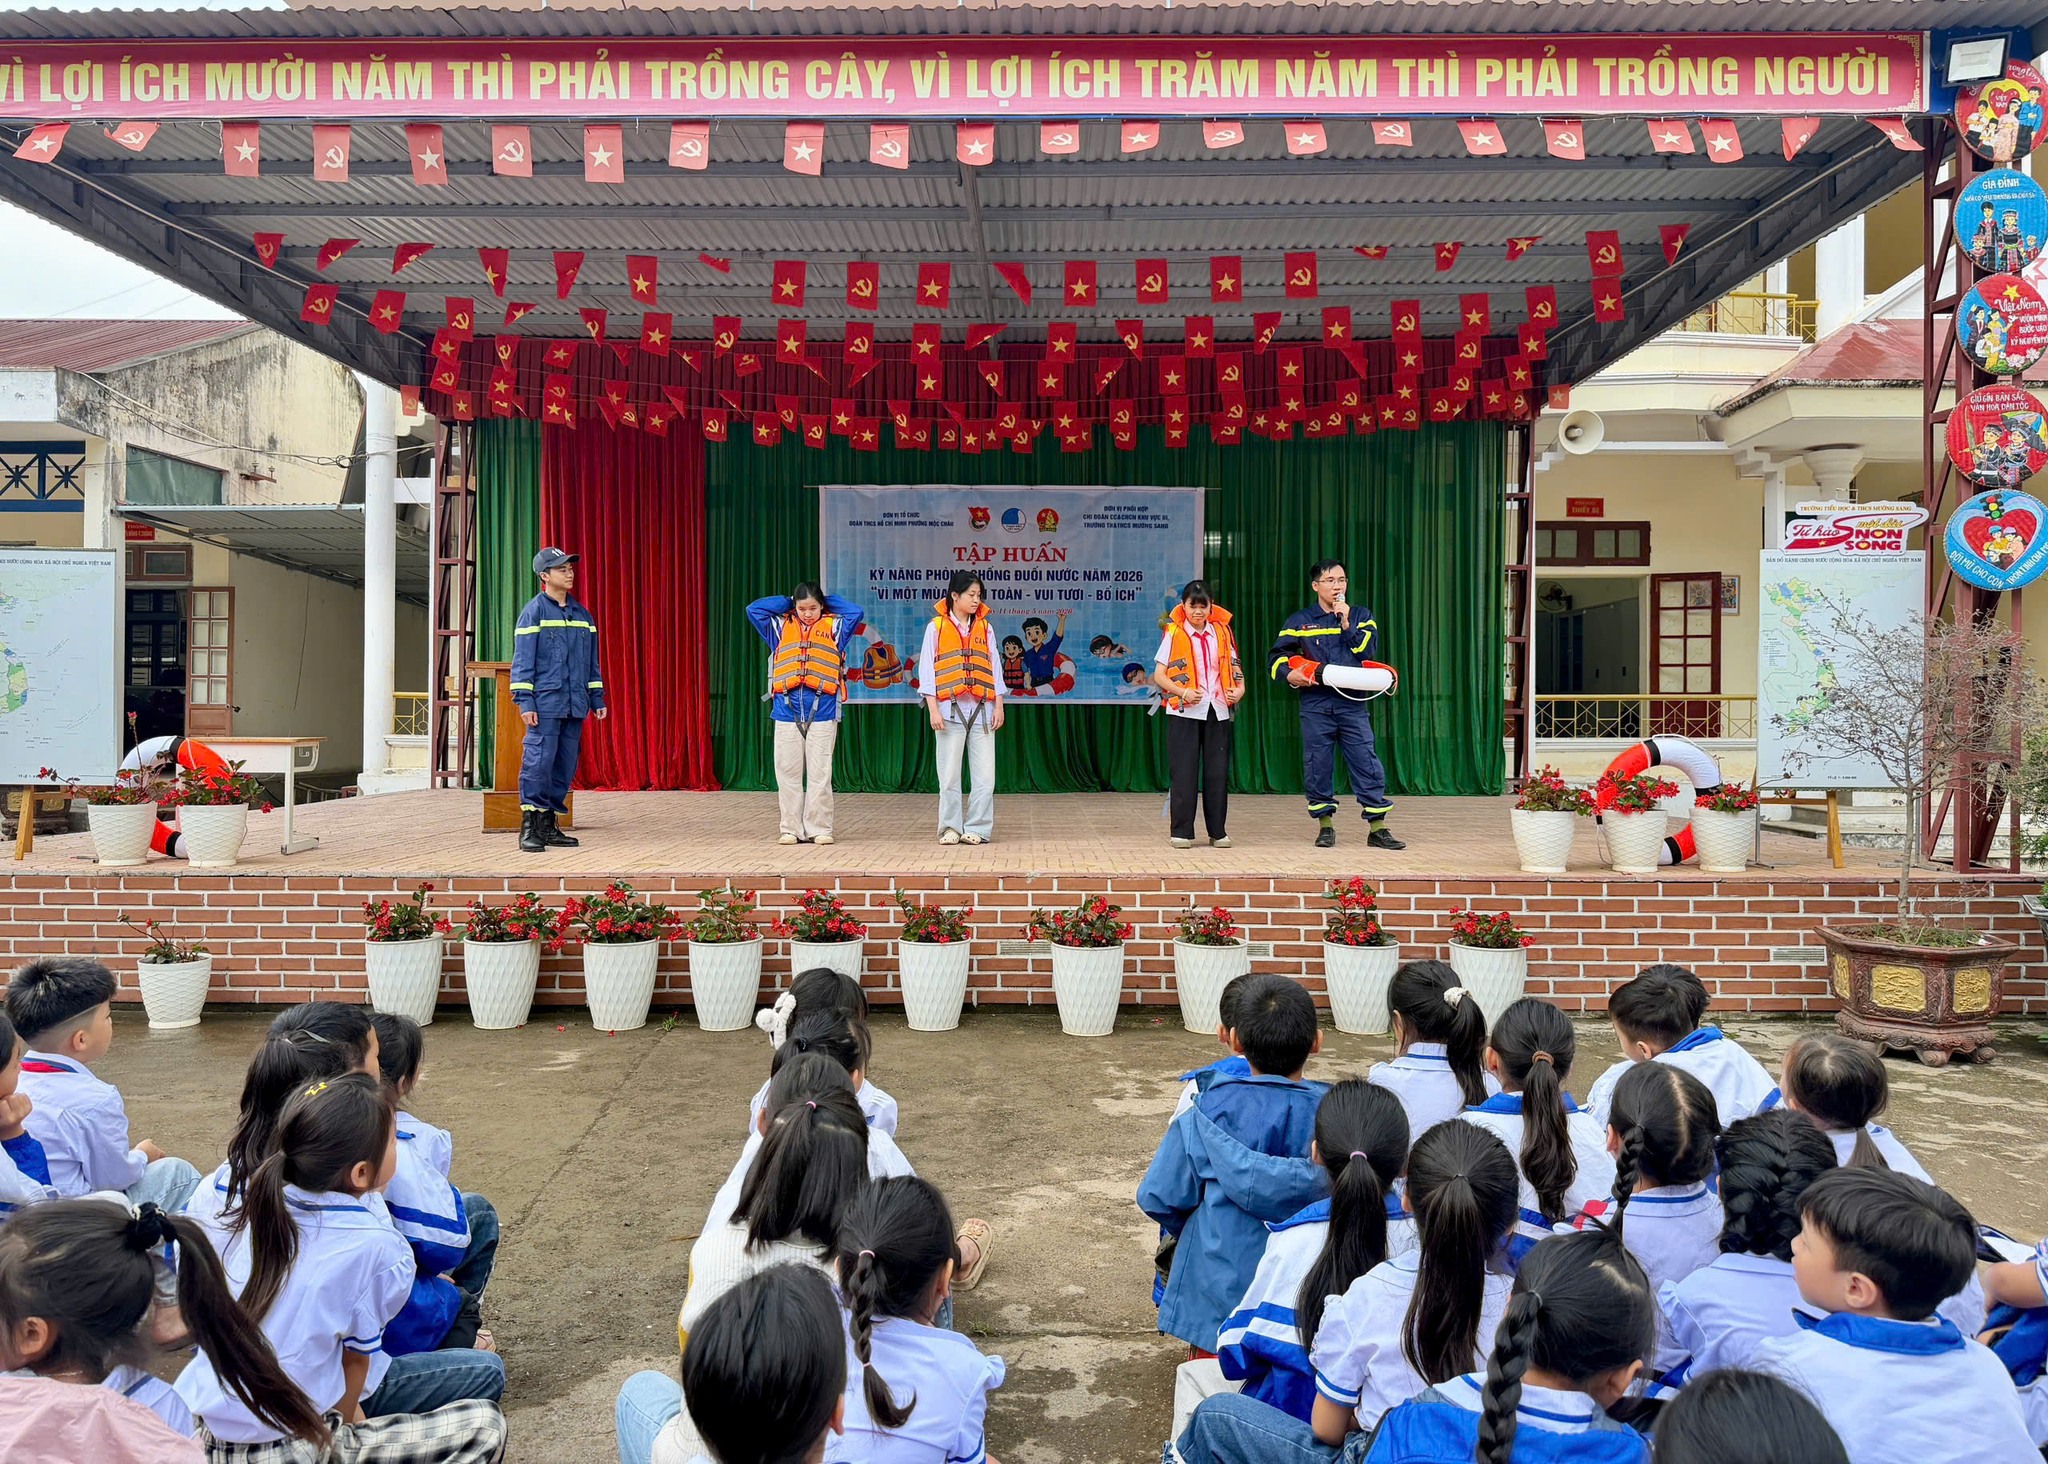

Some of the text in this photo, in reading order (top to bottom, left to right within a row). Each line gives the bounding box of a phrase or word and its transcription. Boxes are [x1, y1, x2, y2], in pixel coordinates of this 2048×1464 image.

[40, 60, 104, 110] LỢI
[119, 56, 189, 102] ÍCH
[205, 51, 312, 102] MƯỜI
[333, 51, 433, 101] NĂM
[447, 53, 514, 101] THÌ
[530, 47, 630, 100] PHẢI
[645, 47, 789, 100] TRỒNG
[806, 52, 895, 104] CÂY,
[910, 51, 950, 99] VÌ
[966, 54, 1032, 107] LỢI
[1049, 50, 1120, 99] ÍCH
[1135, 50, 1259, 99] TRĂM
[1276, 50, 1377, 98] NĂM
[1393, 50, 1459, 98] THÌ
[1476, 44, 1577, 97] PHẢI
[1593, 44, 1739, 97] TRỒNG
[1754, 46, 1889, 97] NGƯỜI
[1982, 178, 1996, 190] GIA
[1855, 529, 1903, 539] NON
[1844, 538, 1901, 550] SÔNG
[953, 542, 1068, 566] TẬP HUẤN
[870, 566, 885, 580] KỸ
[889, 566, 922, 580] NĂNG
[926, 566, 965, 580] PHÒN
[1014, 566, 1042, 581] ĐUỐI
[1046, 568, 1079, 581] NƯỚC
[1083, 568, 1110, 581] NĂM
[1114, 570, 1143, 582] 2026
[1972, 565, 1989, 579] CHO
[1987, 575, 2005, 588] CON
[893, 586, 918, 602] MỘT
[991, 586, 1022, 600] TOÀN
[1035, 589, 1053, 600] VUI
[1058, 588, 1083, 600] TƯƠI
[1096, 586, 1112, 601] BỔ
